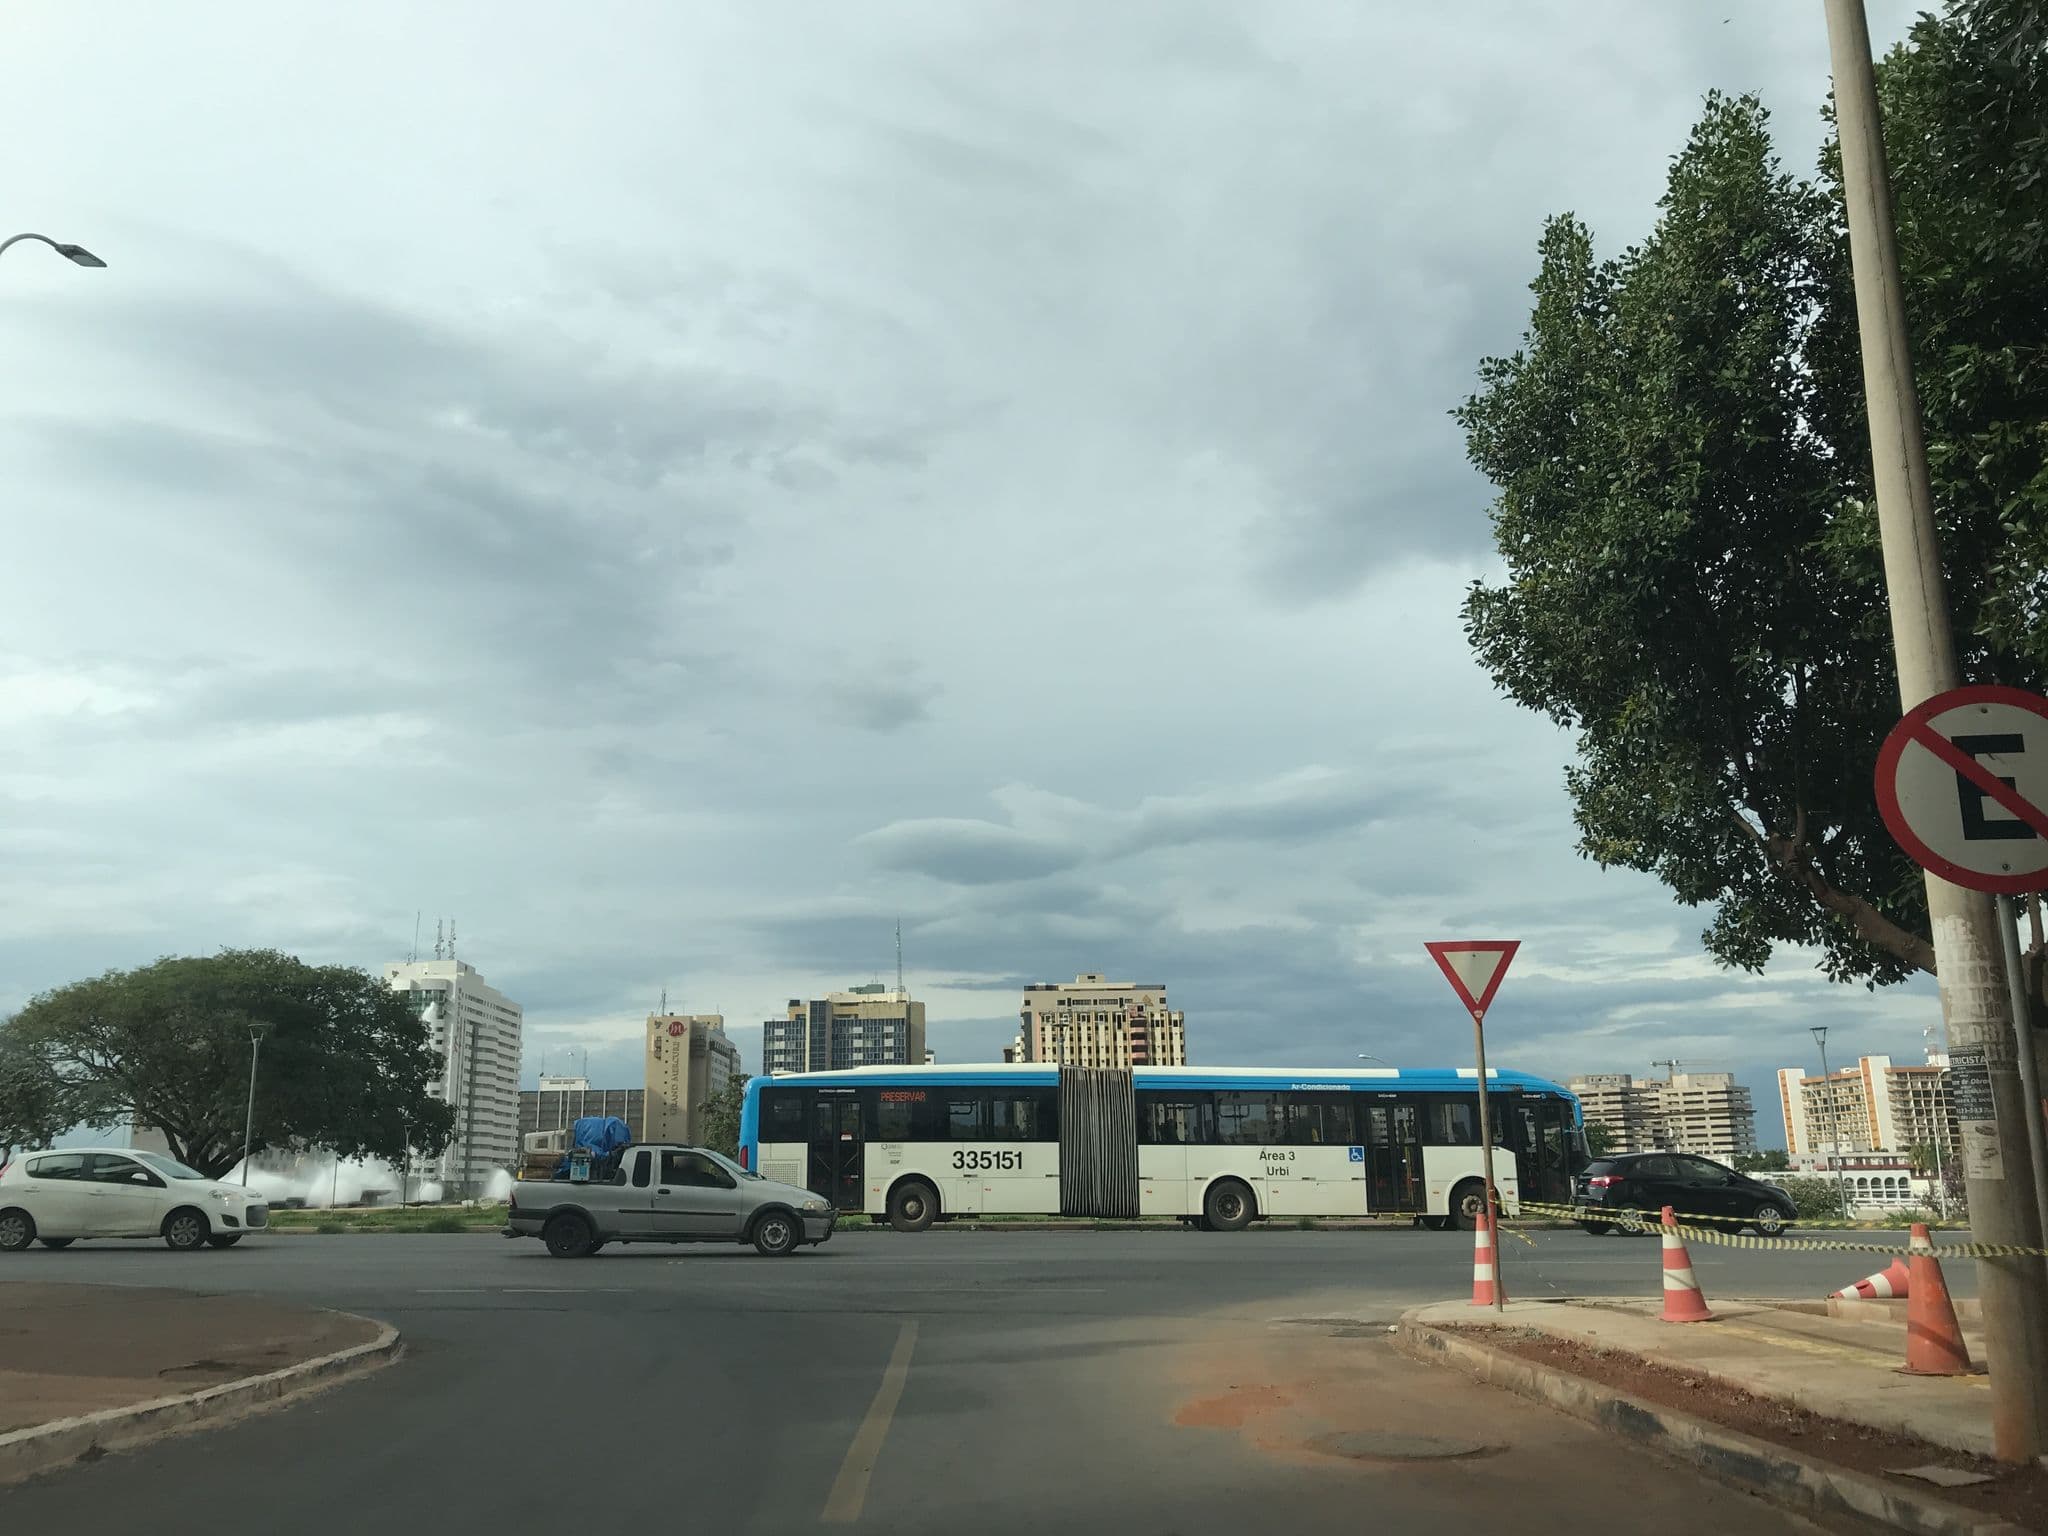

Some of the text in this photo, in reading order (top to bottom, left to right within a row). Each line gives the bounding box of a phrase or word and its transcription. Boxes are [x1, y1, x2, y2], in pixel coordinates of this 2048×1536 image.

[1950, 733, 2038, 841] E
[880, 1091, 926, 1102] PRESERVAR
[952, 1150, 1022, 1170] 335151
[1259, 1147, 1295, 1161] Área 3
[1267, 1167, 1289, 1176] Urbi
